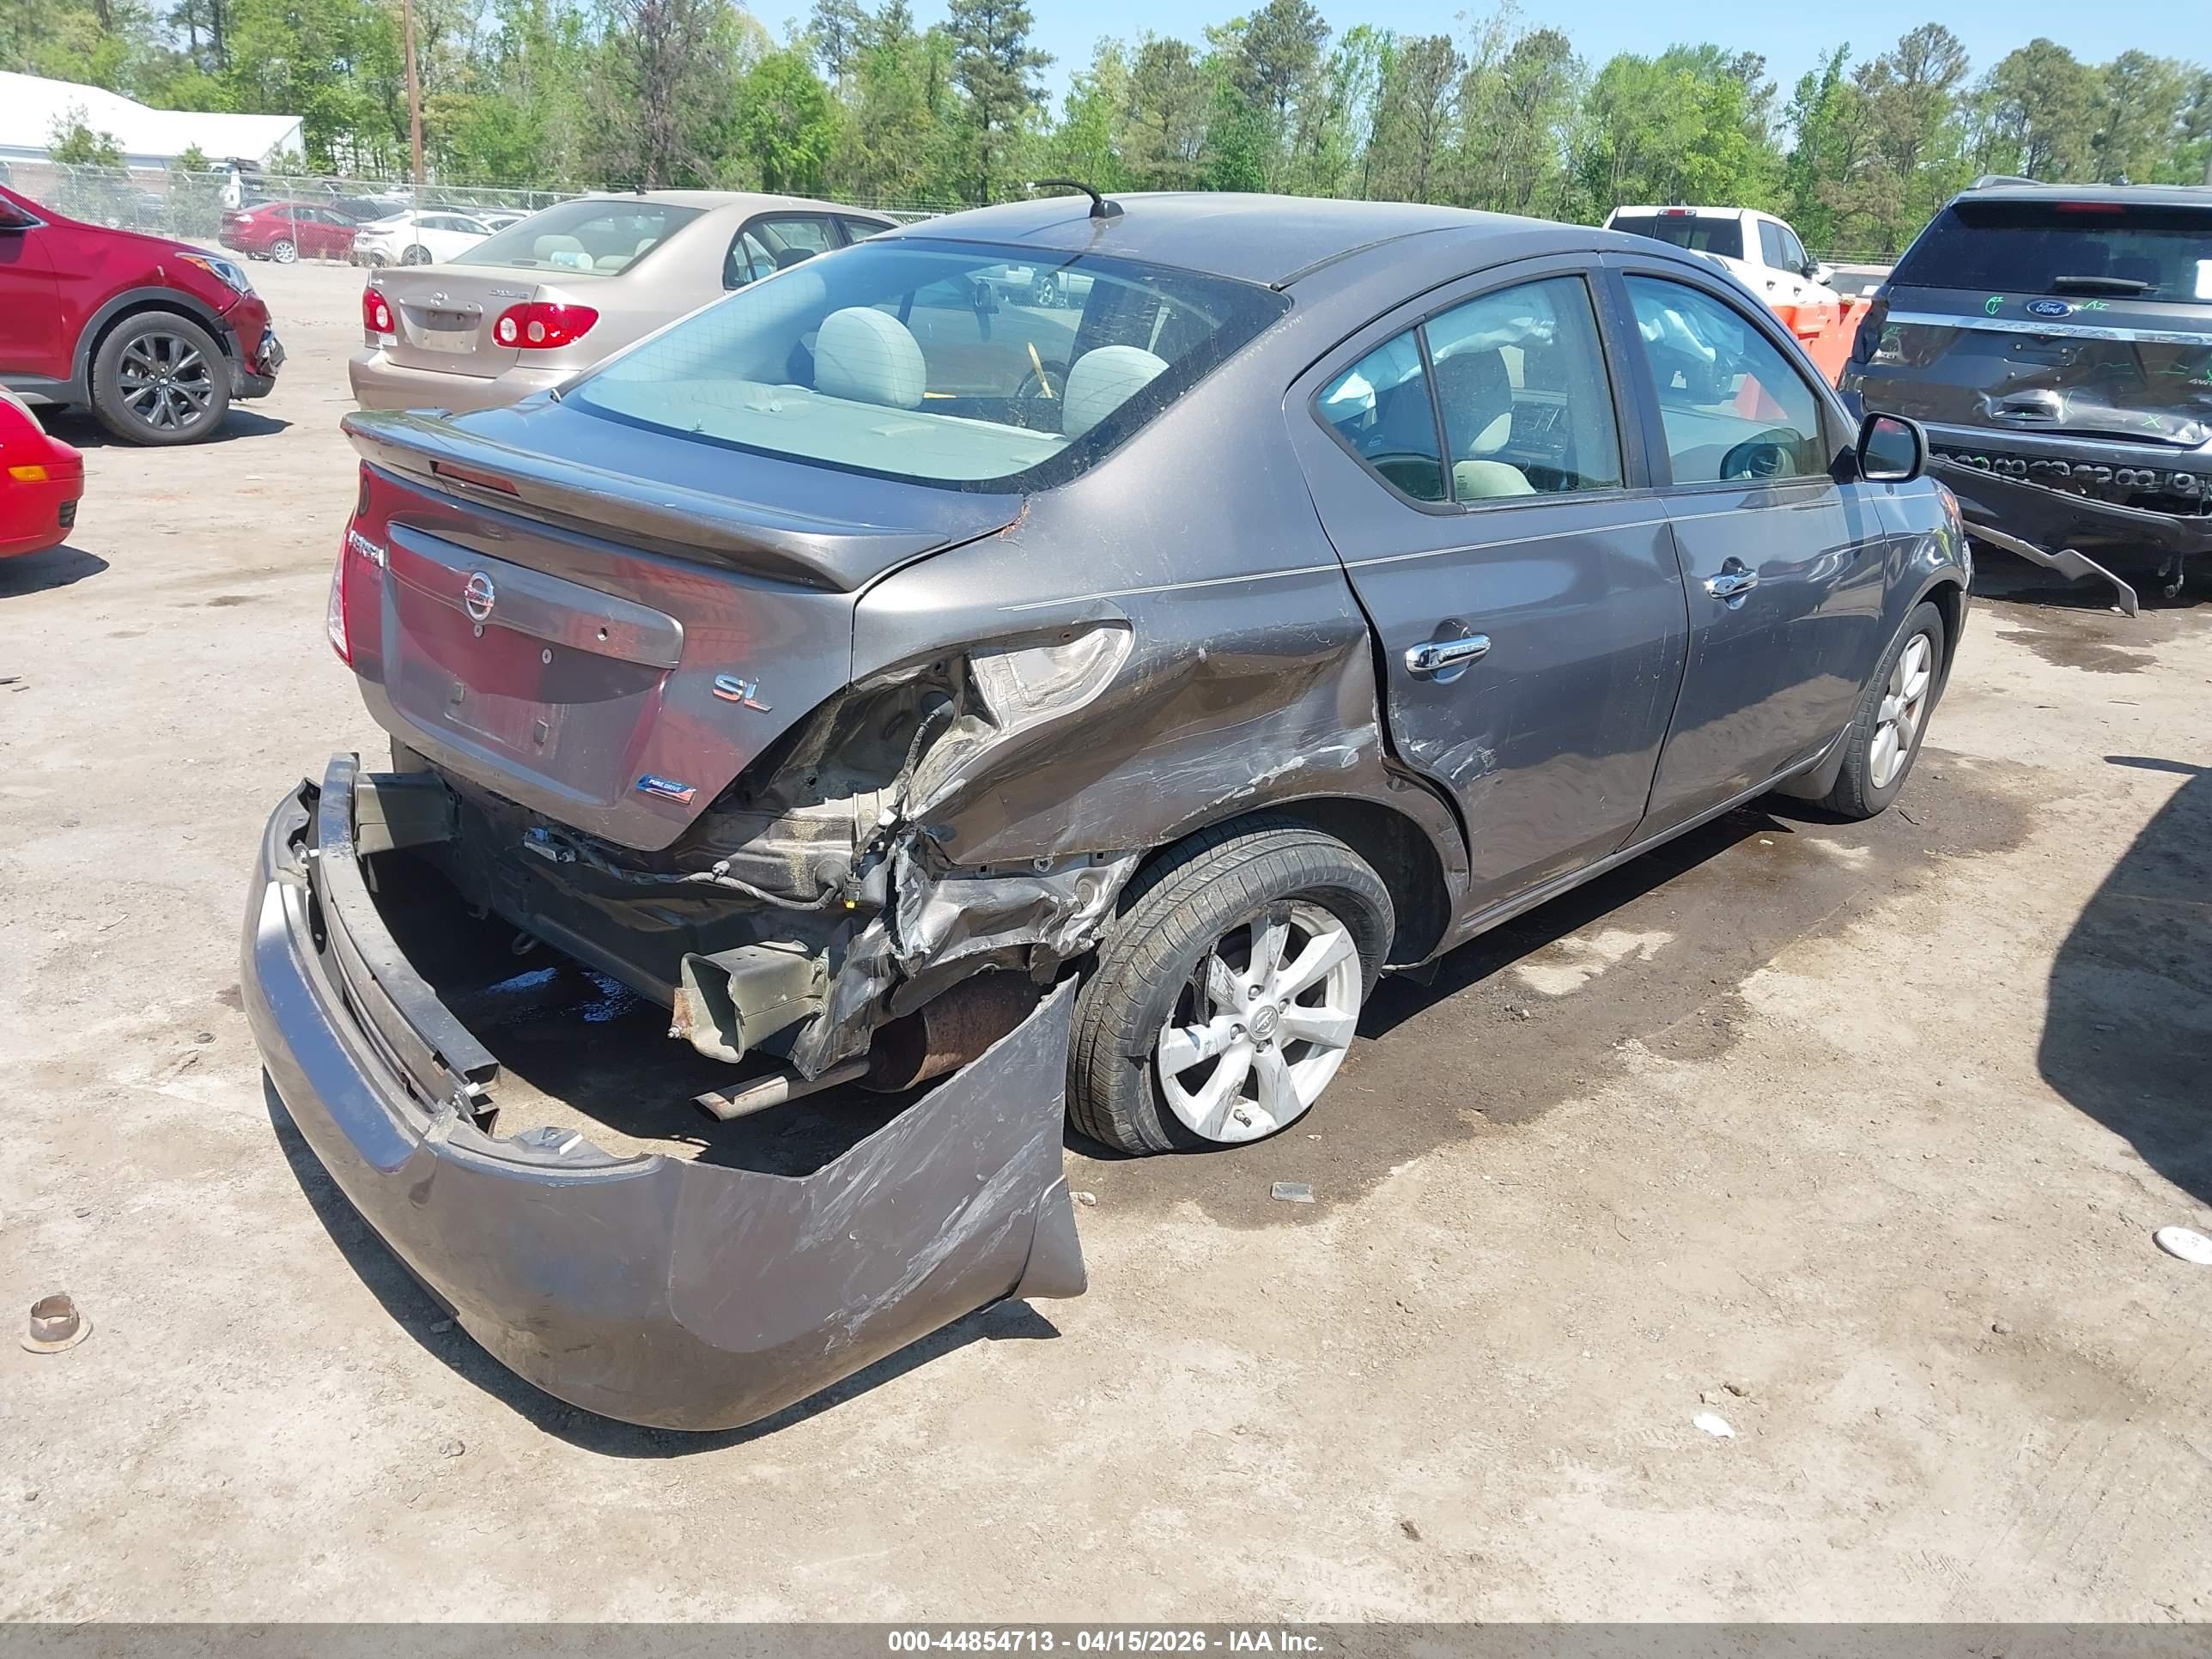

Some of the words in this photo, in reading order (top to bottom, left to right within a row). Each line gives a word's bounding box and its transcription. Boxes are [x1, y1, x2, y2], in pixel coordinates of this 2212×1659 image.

[2035, 301, 2062, 314] Ford
[713, 673, 774, 713] SL
[648, 778, 665, 788] PURE
[664, 782, 682, 793] DRIVE
